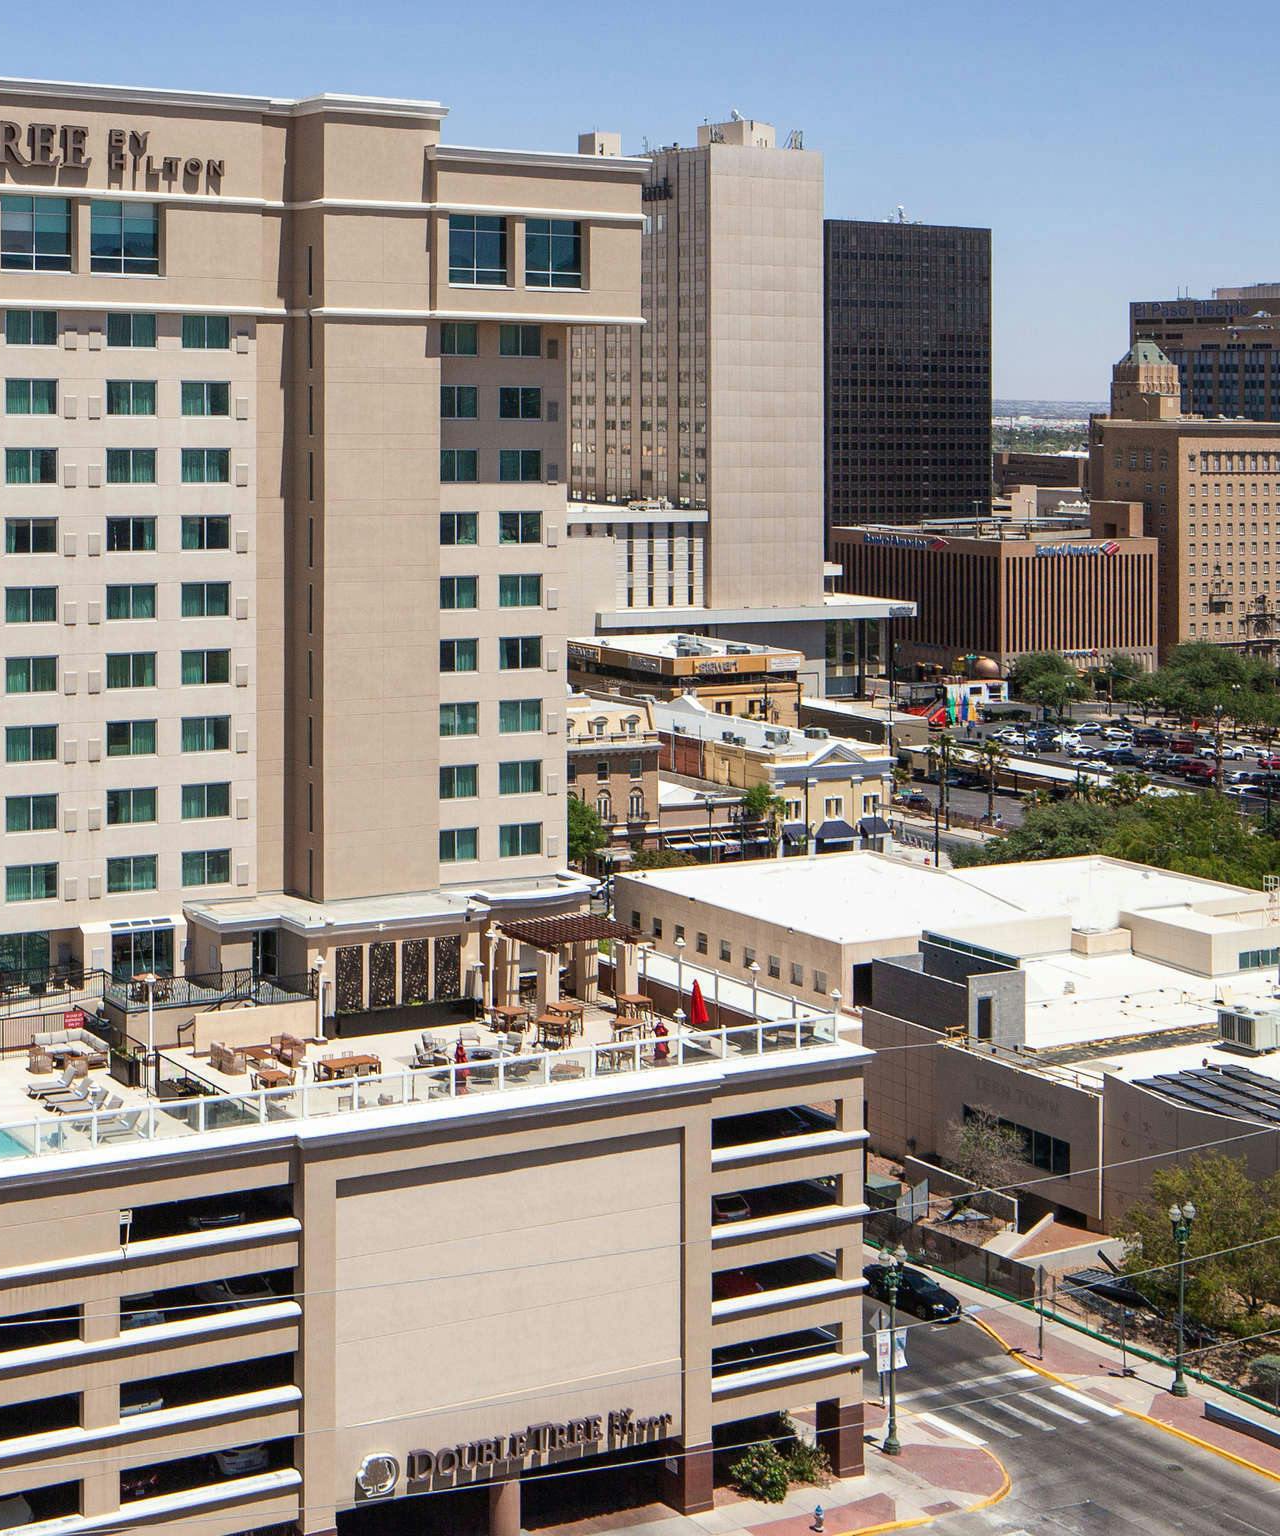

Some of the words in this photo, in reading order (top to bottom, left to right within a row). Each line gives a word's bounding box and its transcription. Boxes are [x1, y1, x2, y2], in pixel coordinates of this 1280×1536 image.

[110, 129, 149, 148] BY
[110, 152, 225, 177] HILTON
[1134, 303, 1147, 317] El
[1151, 303, 1188, 317] Paso
[1193, 302, 1250, 316] Electric
